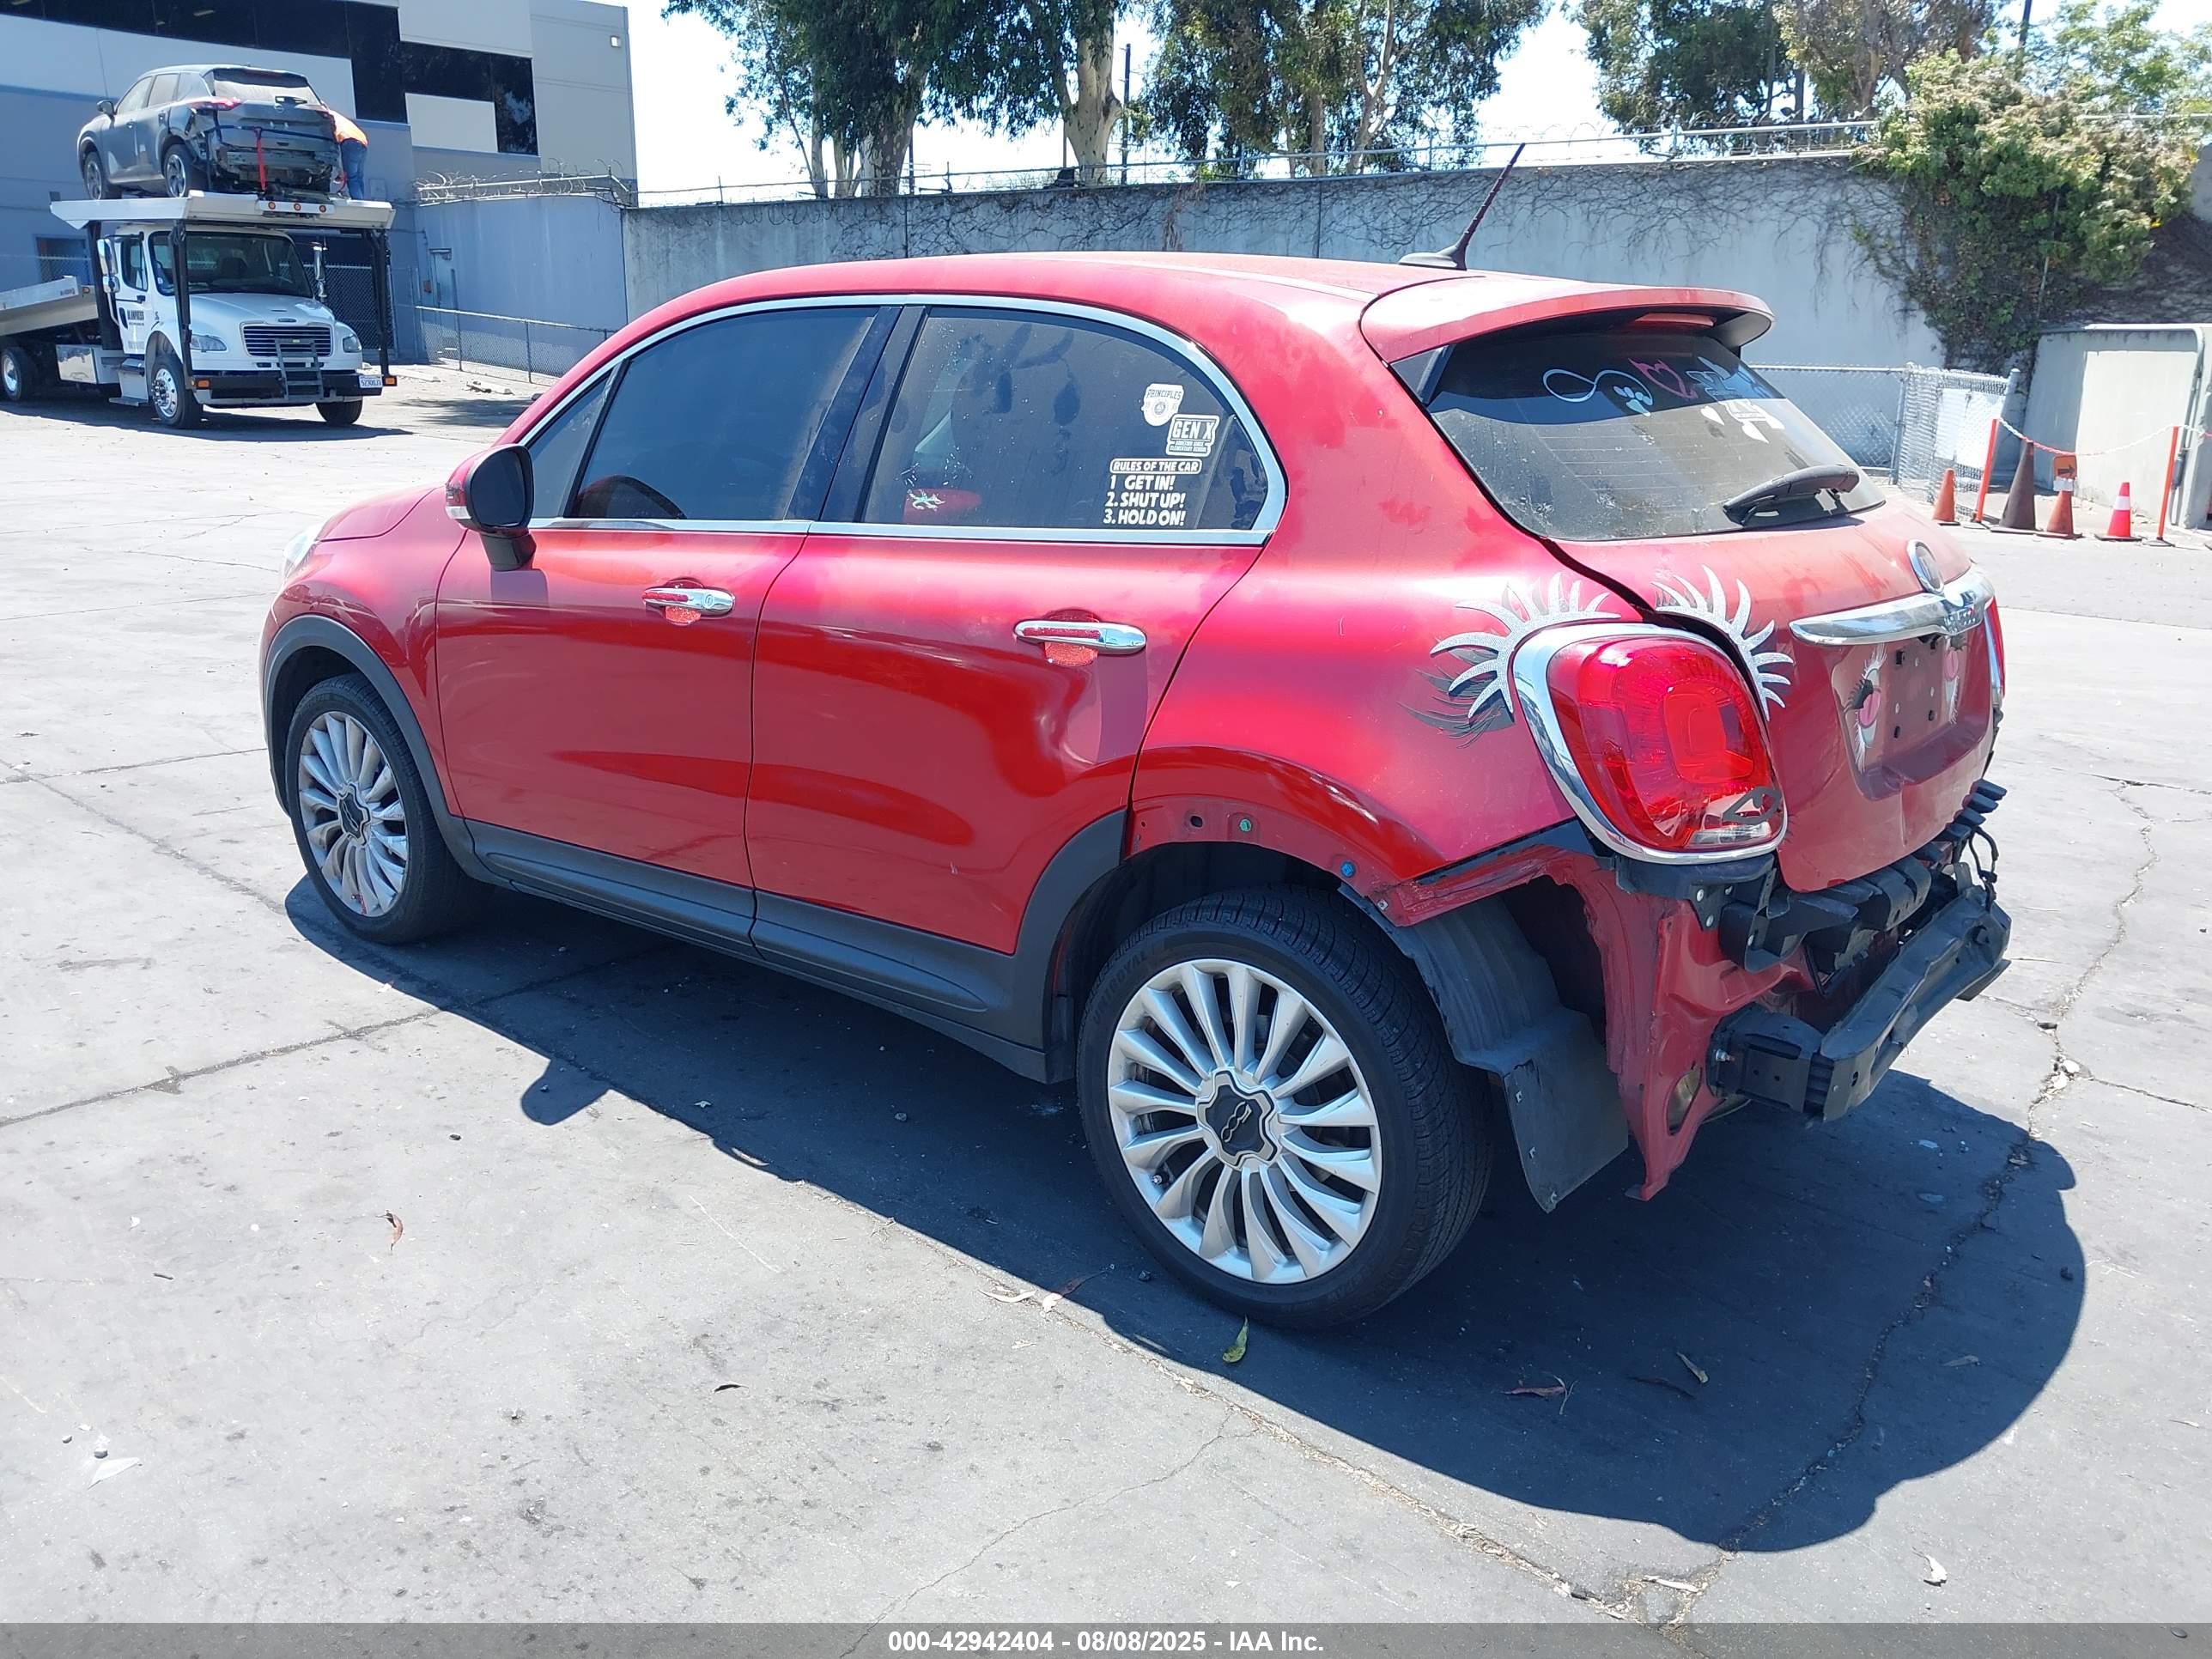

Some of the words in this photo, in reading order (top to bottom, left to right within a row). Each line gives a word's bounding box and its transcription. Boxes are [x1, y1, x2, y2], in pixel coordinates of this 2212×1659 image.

[1146, 388, 1182, 400] PRINCIPLES
[1173, 422, 1200, 440] GEN
[1203, 422, 1216, 440] X
[1112, 461, 1142, 471] RULES
[1144, 461, 1157, 471] OF
[1158, 461, 1177, 472] THE
[1178, 462, 1199, 472] CAR
[1124, 475, 1155, 490] GET
[1153, 476, 1176, 490] IN!
[1105, 492, 1118, 507] 2.
[1120, 493, 1160, 508] SHUT
[1159, 493, 1186, 508] UP!
[1103, 508, 1116, 525] 3.
[1117, 509, 1158, 526] HOLD
[1158, 510, 1187, 526] ON!
